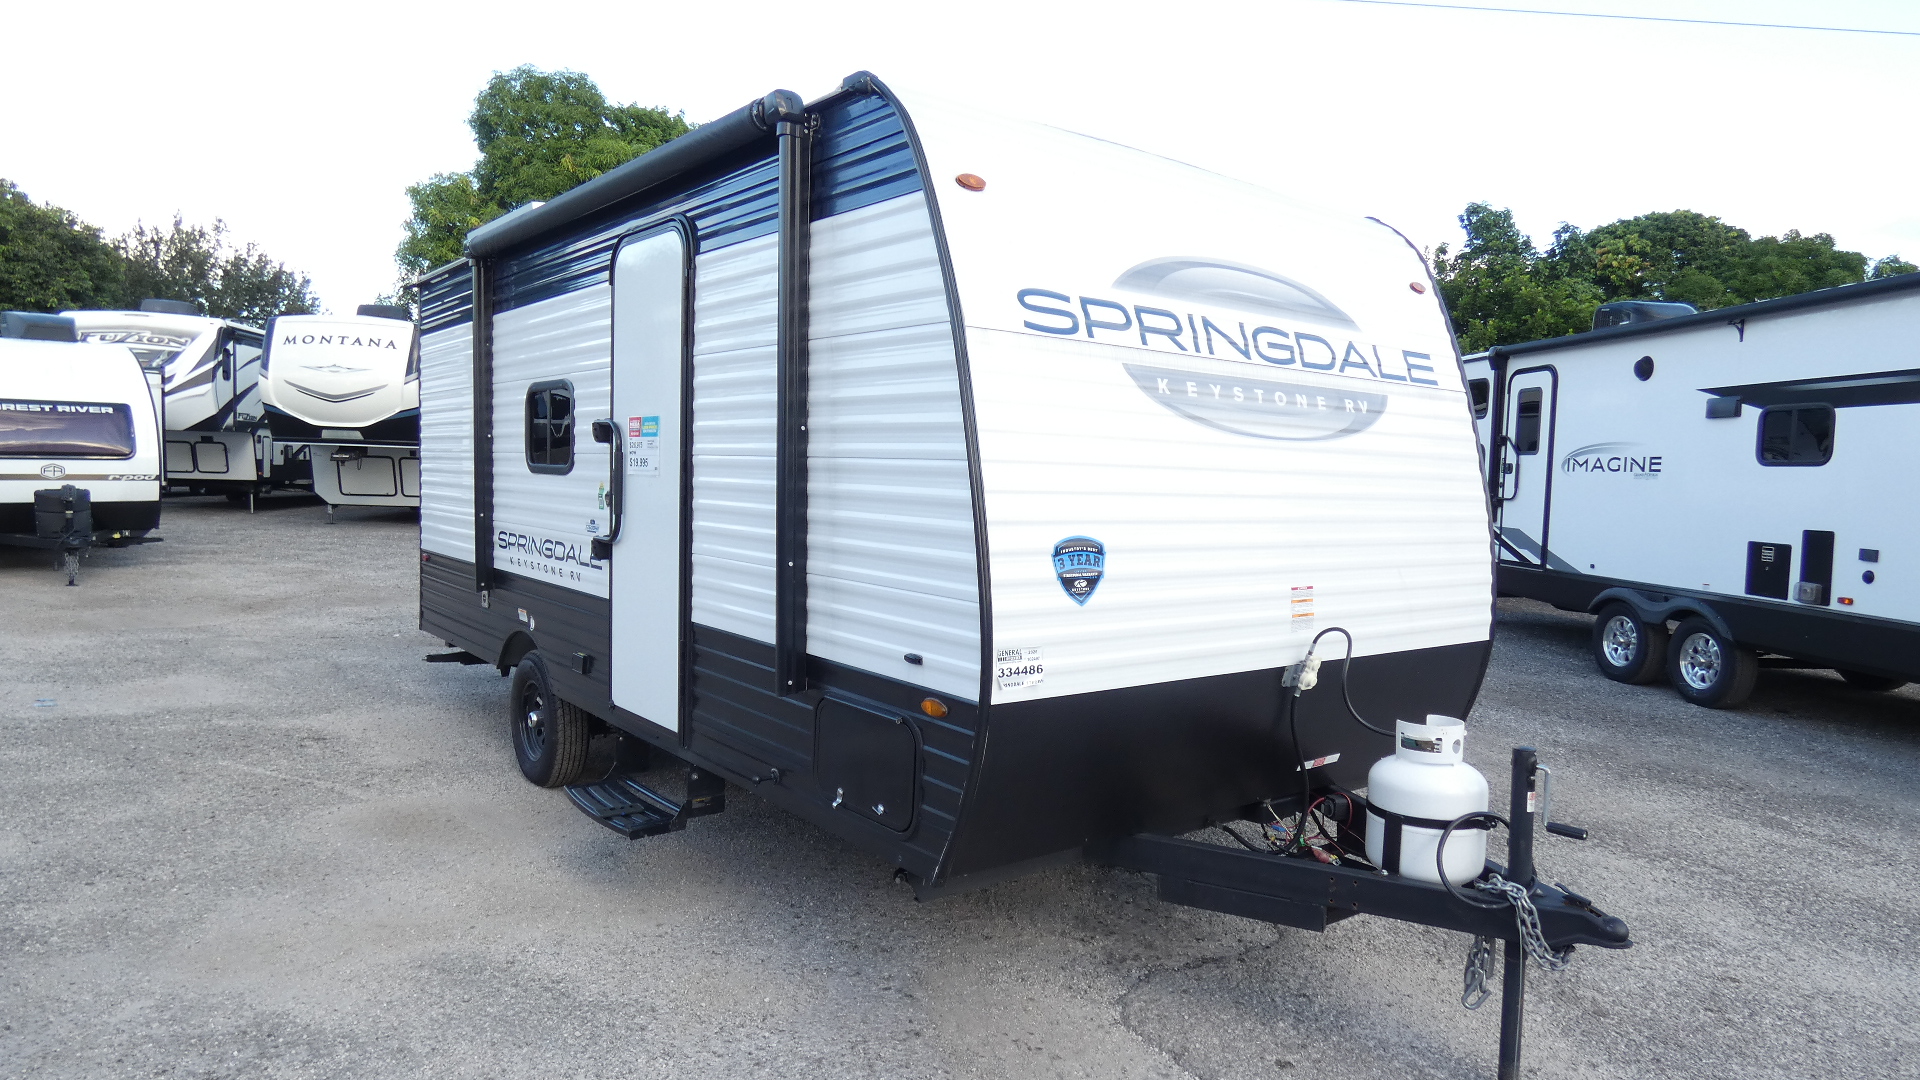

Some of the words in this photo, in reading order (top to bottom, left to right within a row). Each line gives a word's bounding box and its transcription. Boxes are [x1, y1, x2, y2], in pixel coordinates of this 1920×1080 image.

[283, 335, 397, 350] MONTANA
[1016, 287, 1438, 386] SPRINGDALE
[1157, 377, 1327, 411] KEYSTONE
[1344, 398, 1368, 415] RV
[0, 403, 53, 412] REST
[57, 405, 114, 414] RIVER
[1566, 456, 1662, 472] IMAGINE
[497, 530, 603, 571] SPRINGDALE
[510, 556, 564, 577] KEYSTONE
[570, 570, 581, 582] RV
[1057, 557, 1066, 571] 3
[1067, 553, 1101, 568] YEAR
[997, 664, 1044, 679] 334486
